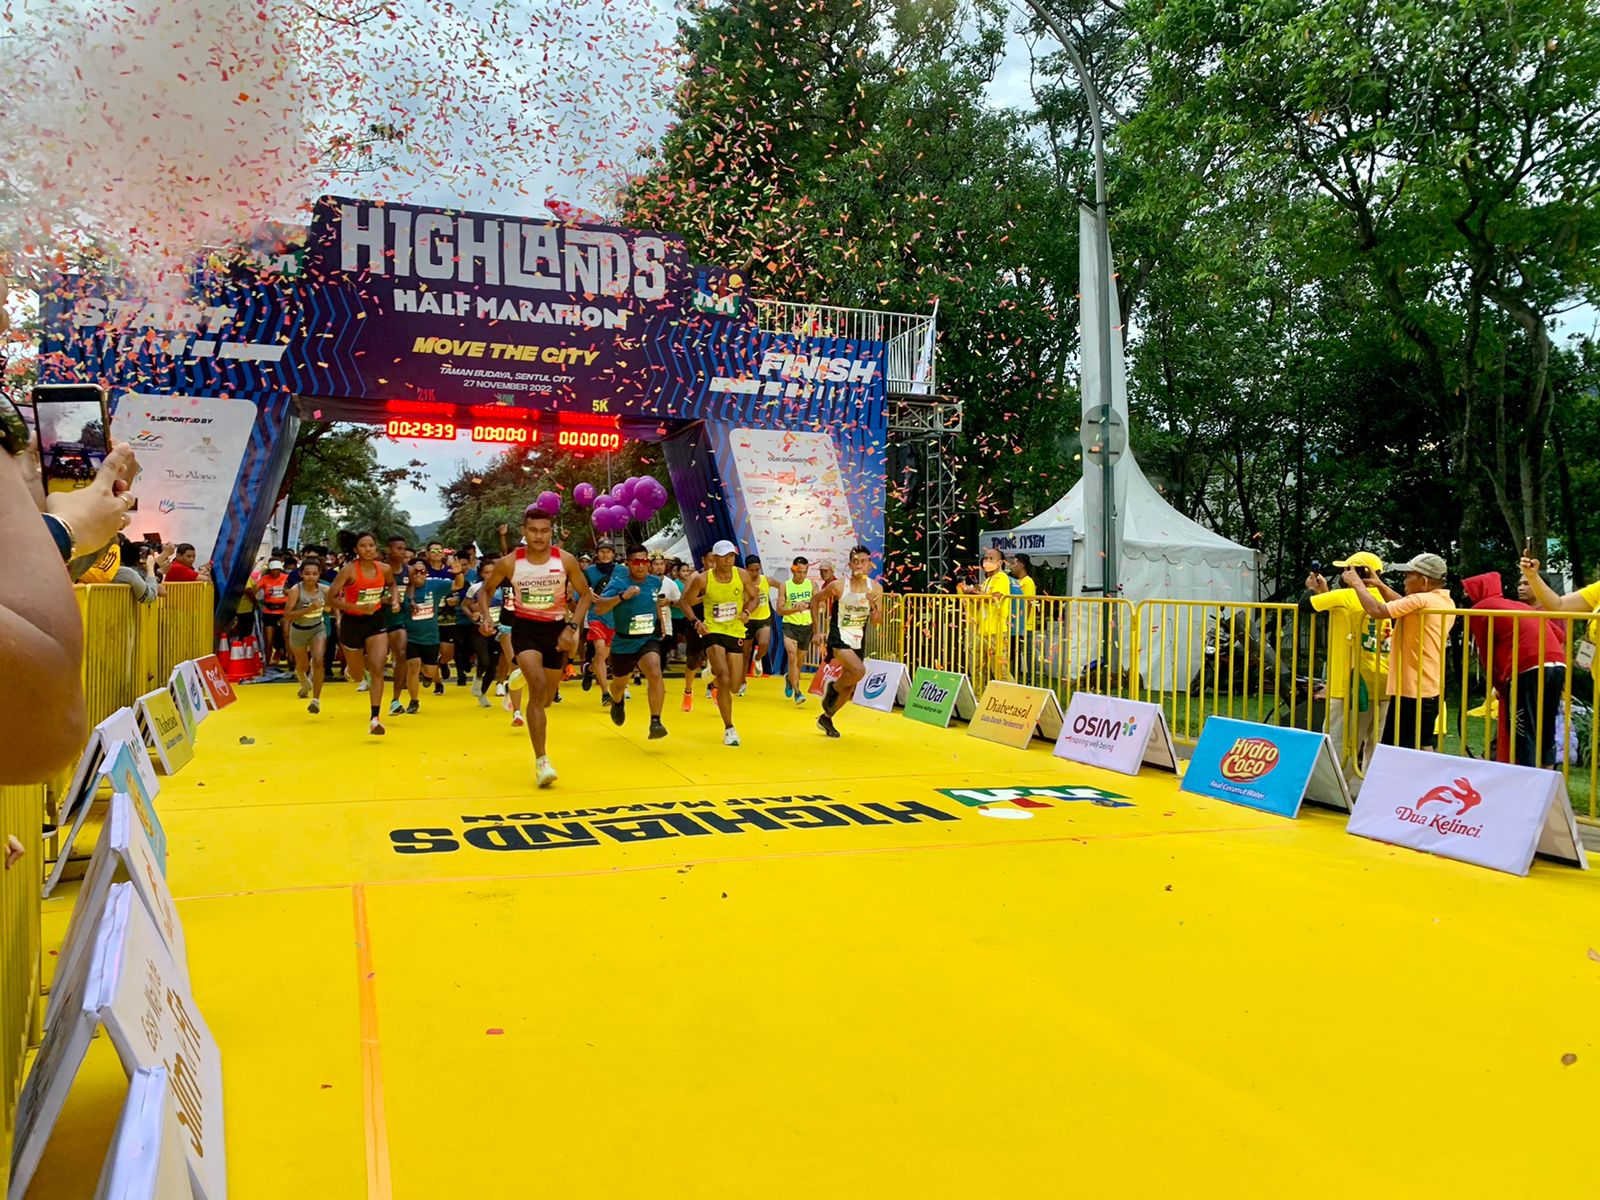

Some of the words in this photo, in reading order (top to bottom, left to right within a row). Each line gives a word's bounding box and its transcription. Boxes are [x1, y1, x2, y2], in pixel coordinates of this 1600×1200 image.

[74, 297, 237, 334] START
[393, 288, 471, 317] HALF
[477, 296, 628, 331] MARATHON
[412, 336, 487, 358] MOVE
[489, 343, 539, 362] THE
[541, 346, 600, 367] CITY
[439, 366, 475, 377] TAMAN
[474, 368, 513, 381] BUDAYA,
[514, 372, 551, 382] SENTUL
[552, 375, 575, 384] CITY
[759, 352, 877, 384] FINISH
[463, 379, 475, 387] 27
[476, 380, 528, 391] NOVEMBER
[529, 384, 552, 393] 2022
[592, 400, 609, 412] 5K
[388, 420, 455, 439] 00:29:39
[473, 425, 537, 442] 00:00:01
[1019, 534, 1046, 549] SYSTEM
[516, 579, 561, 587] INDONESIA
[789, 592, 811, 601] SHR
[915, 680, 949, 704] Fitbar
[985, 696, 1033, 719] Diabetasol
[1073, 714, 1121, 740] OSIM
[1230, 737, 1278, 761] Hydro
[1222, 754, 1266, 777] Coco
[724, 794, 834, 806] HALF
[1222, 783, 1247, 796] Coconut
[1246, 788, 1266, 800] Water
[461, 799, 716, 823] MARATHON
[1395, 805, 1428, 825] Dua
[1428, 813, 1483, 838] Kelinci
[166, 987, 201, 1062] Fit
